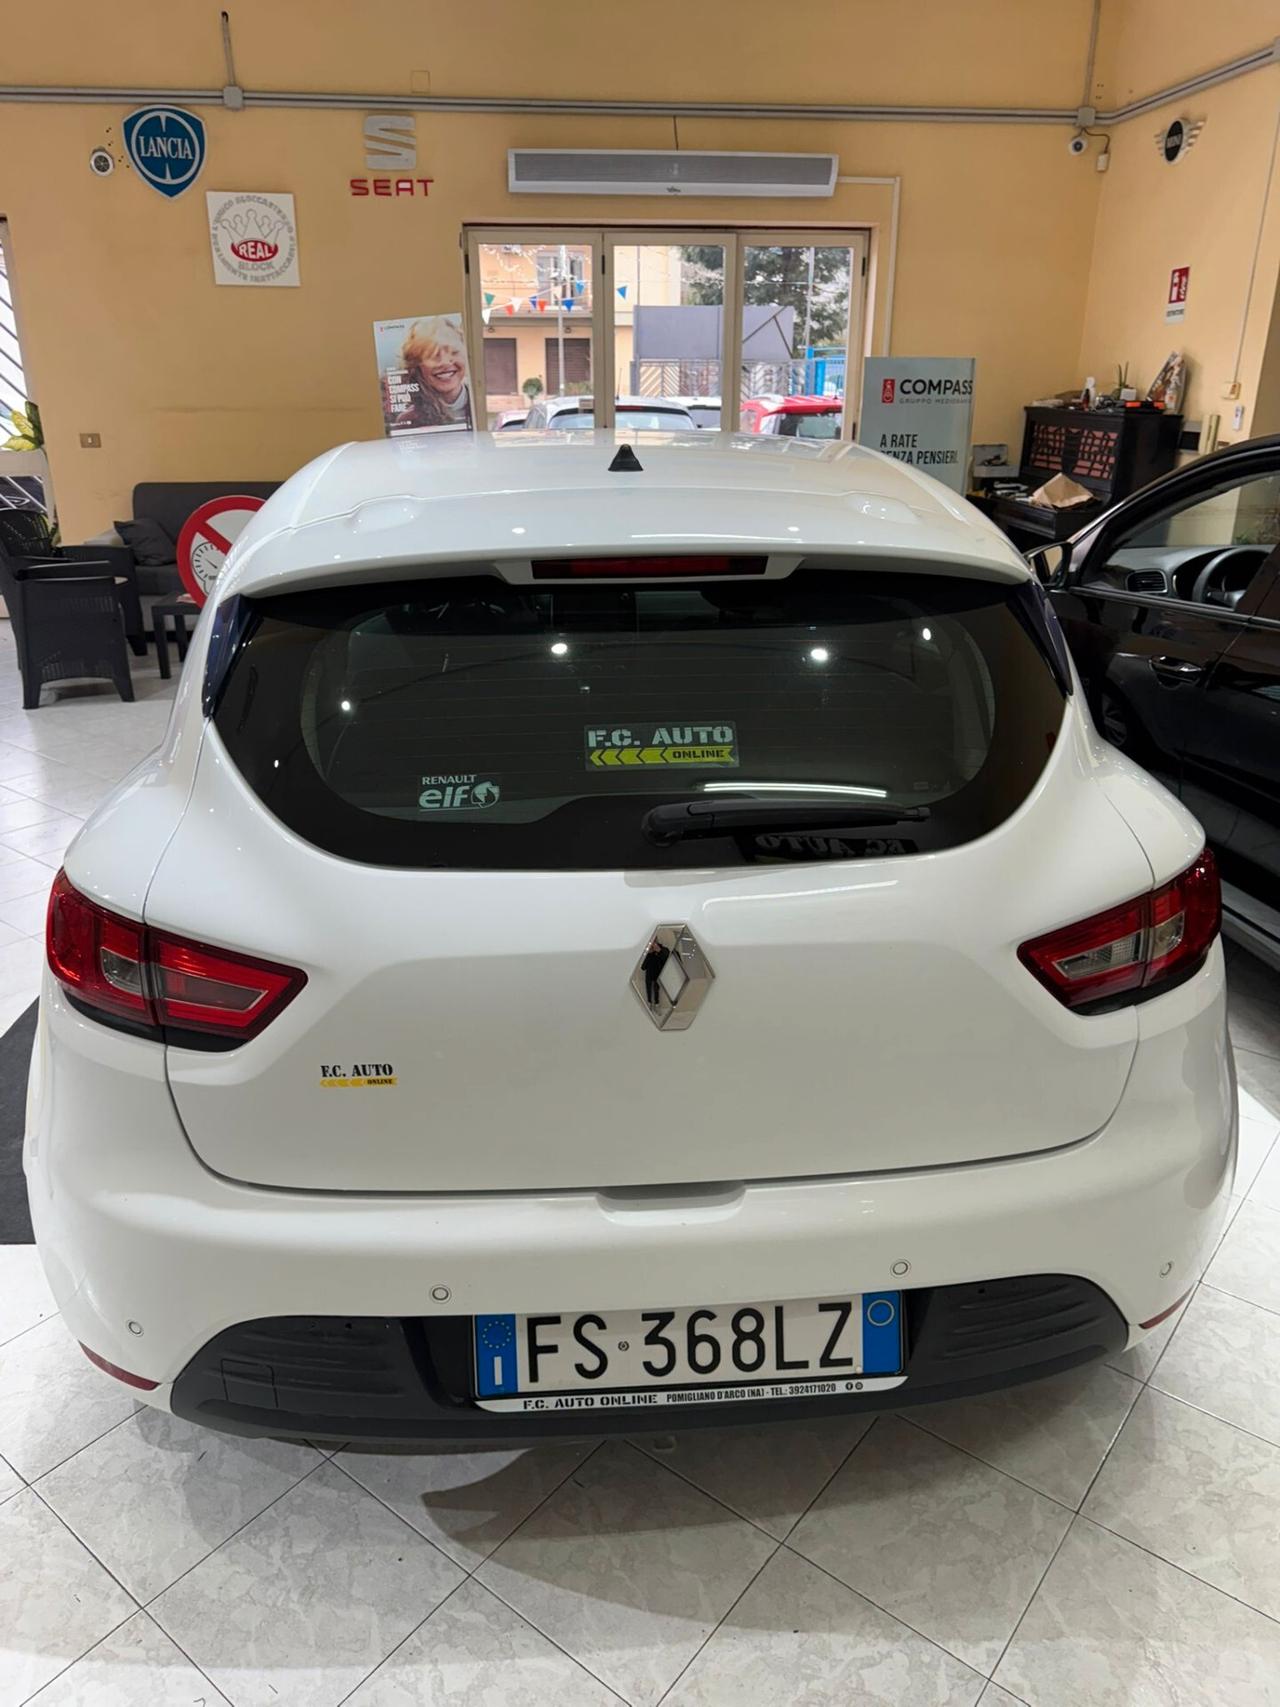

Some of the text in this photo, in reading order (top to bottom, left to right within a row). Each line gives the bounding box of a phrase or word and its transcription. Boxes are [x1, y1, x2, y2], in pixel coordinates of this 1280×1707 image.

[139, 136, 193, 159] LANCIA
[350, 179, 434, 196] SEAT
[239, 241, 273, 259] REAL
[900, 379, 973, 395] COMPASS
[880, 434, 918, 448] A RATE
[588, 726, 734, 748] F.C. AUTO
[672, 749, 724, 759] ONLINE
[422, 774, 477, 785] RENAULT
[419, 785, 471, 808] elf
[320, 1063, 393, 1077] F.C. AUTO
[527, 1301, 854, 1383] FS 368LZ
[523, 1399, 549, 1410] F.C.
[554, 1397, 594, 1409] AUTO
[600, 1394, 658, 1407] ONLINE
[666, 1391, 715, 1403] POMIGLIANO
[717, 1389, 746, 1400] D'ARCO
[788, 1383, 837, 1395] 3924171020
